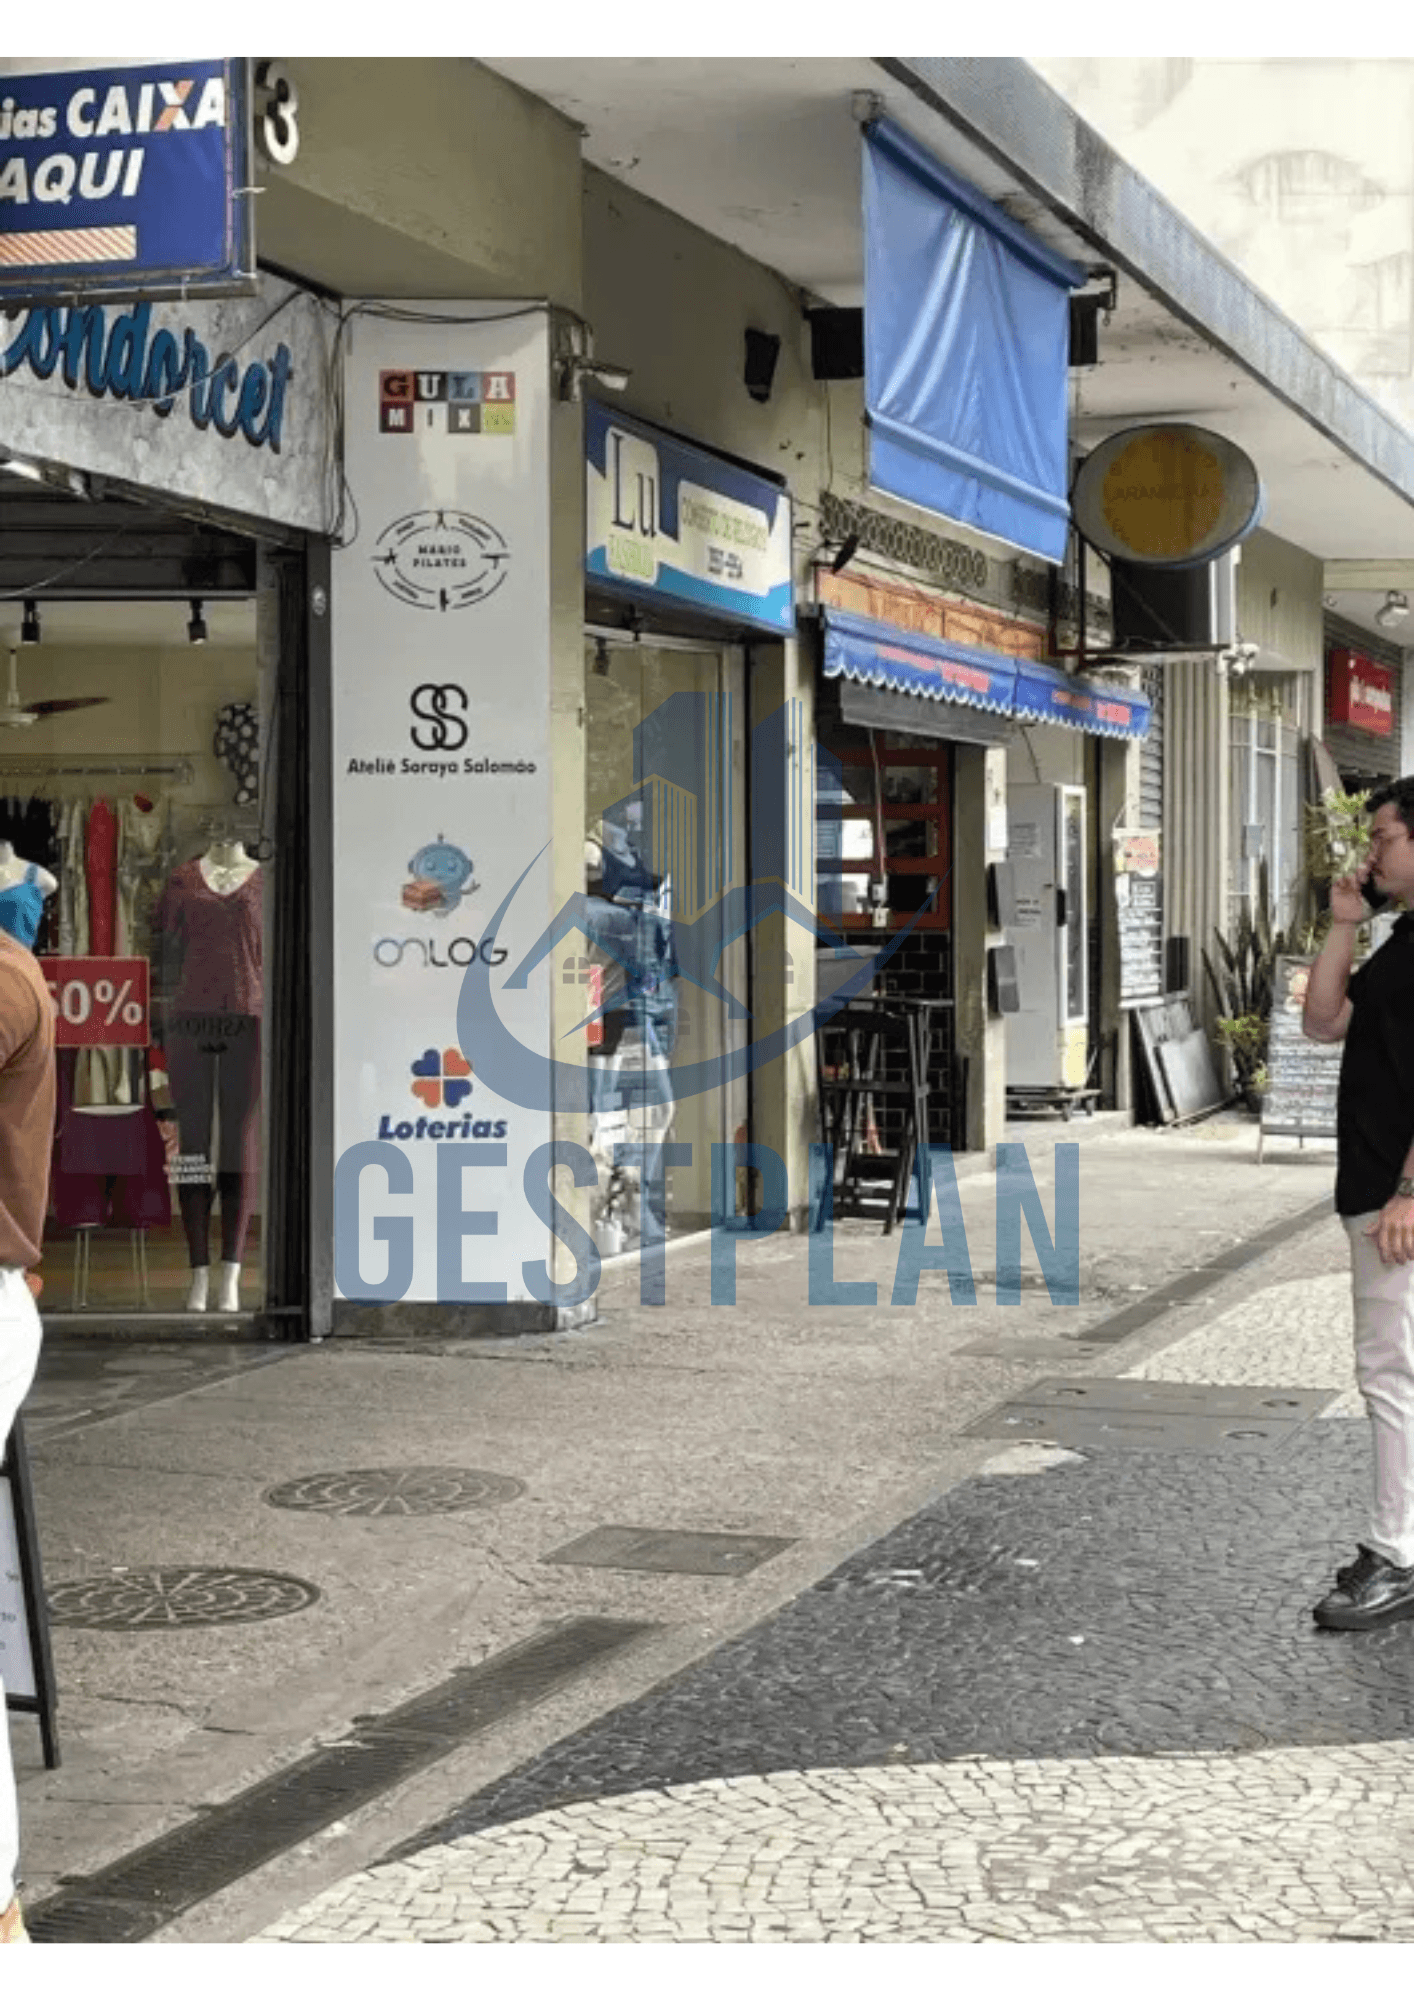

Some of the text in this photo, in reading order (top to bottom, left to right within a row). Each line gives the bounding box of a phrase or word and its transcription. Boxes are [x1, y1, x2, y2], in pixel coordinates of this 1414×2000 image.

[66, 78, 226, 138] CAIXA
[0, 148, 146, 204] AQUI
[383, 374, 511, 400] GULA
[388, 407, 471, 428] MIX
[611, 432, 658, 538] Lu
[401, 757, 459, 778] Soraya
[377, 1112, 508, 1141] Loterias
